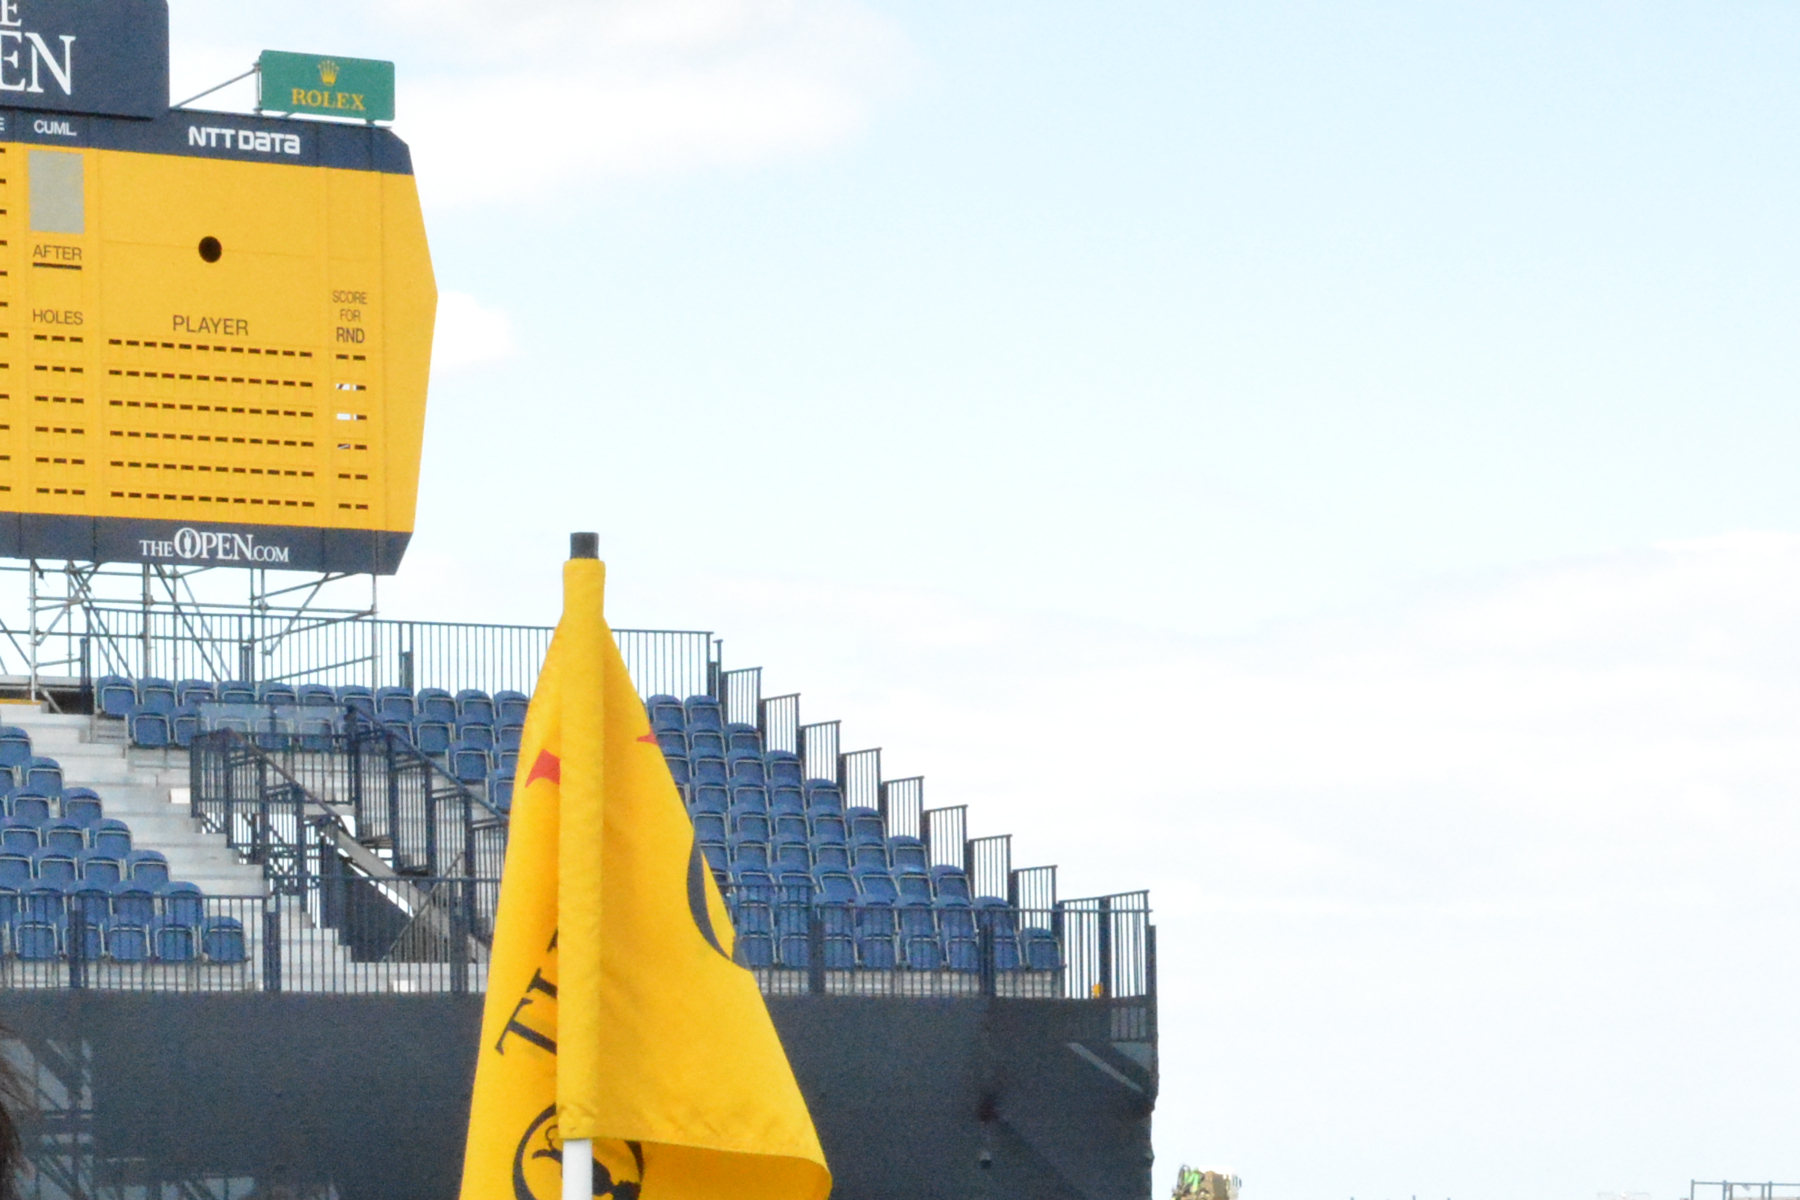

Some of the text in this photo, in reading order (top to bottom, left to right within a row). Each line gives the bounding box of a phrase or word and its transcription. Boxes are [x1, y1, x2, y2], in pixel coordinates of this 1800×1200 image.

[291, 88, 366, 111] ROLEX
[188, 125, 236, 149] NTT
[32, 244, 83, 262] AFTER
[332, 290, 368, 305] SCORE
[32, 309, 84, 326] HOLES
[339, 308, 361, 322] FOR
[172, 315, 249, 337] PLAYER
[336, 327, 365, 344] RND
